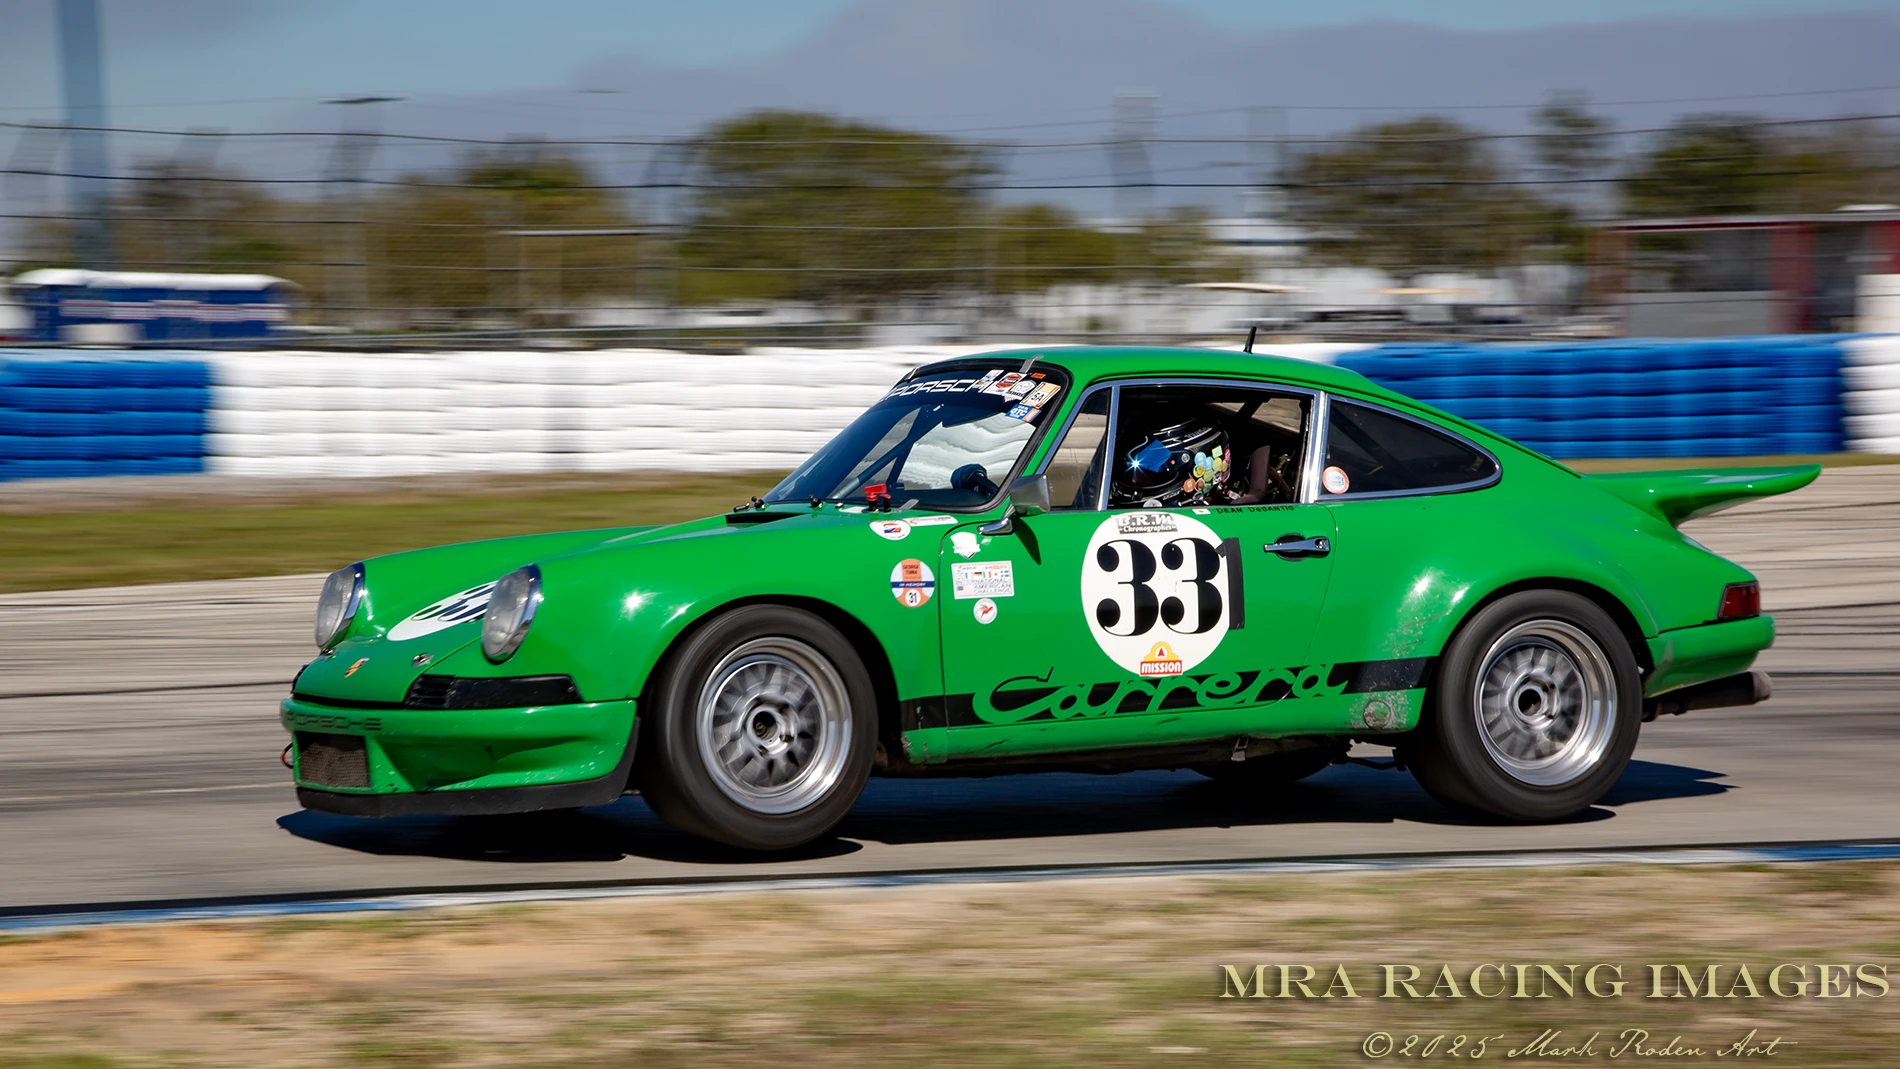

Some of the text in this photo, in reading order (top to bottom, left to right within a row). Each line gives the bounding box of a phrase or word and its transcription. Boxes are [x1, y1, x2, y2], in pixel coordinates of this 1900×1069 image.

[883, 379, 994, 401] PORSCH
[1141, 661, 1181, 674] MISSION
[972, 662, 1350, 724] Carrera
